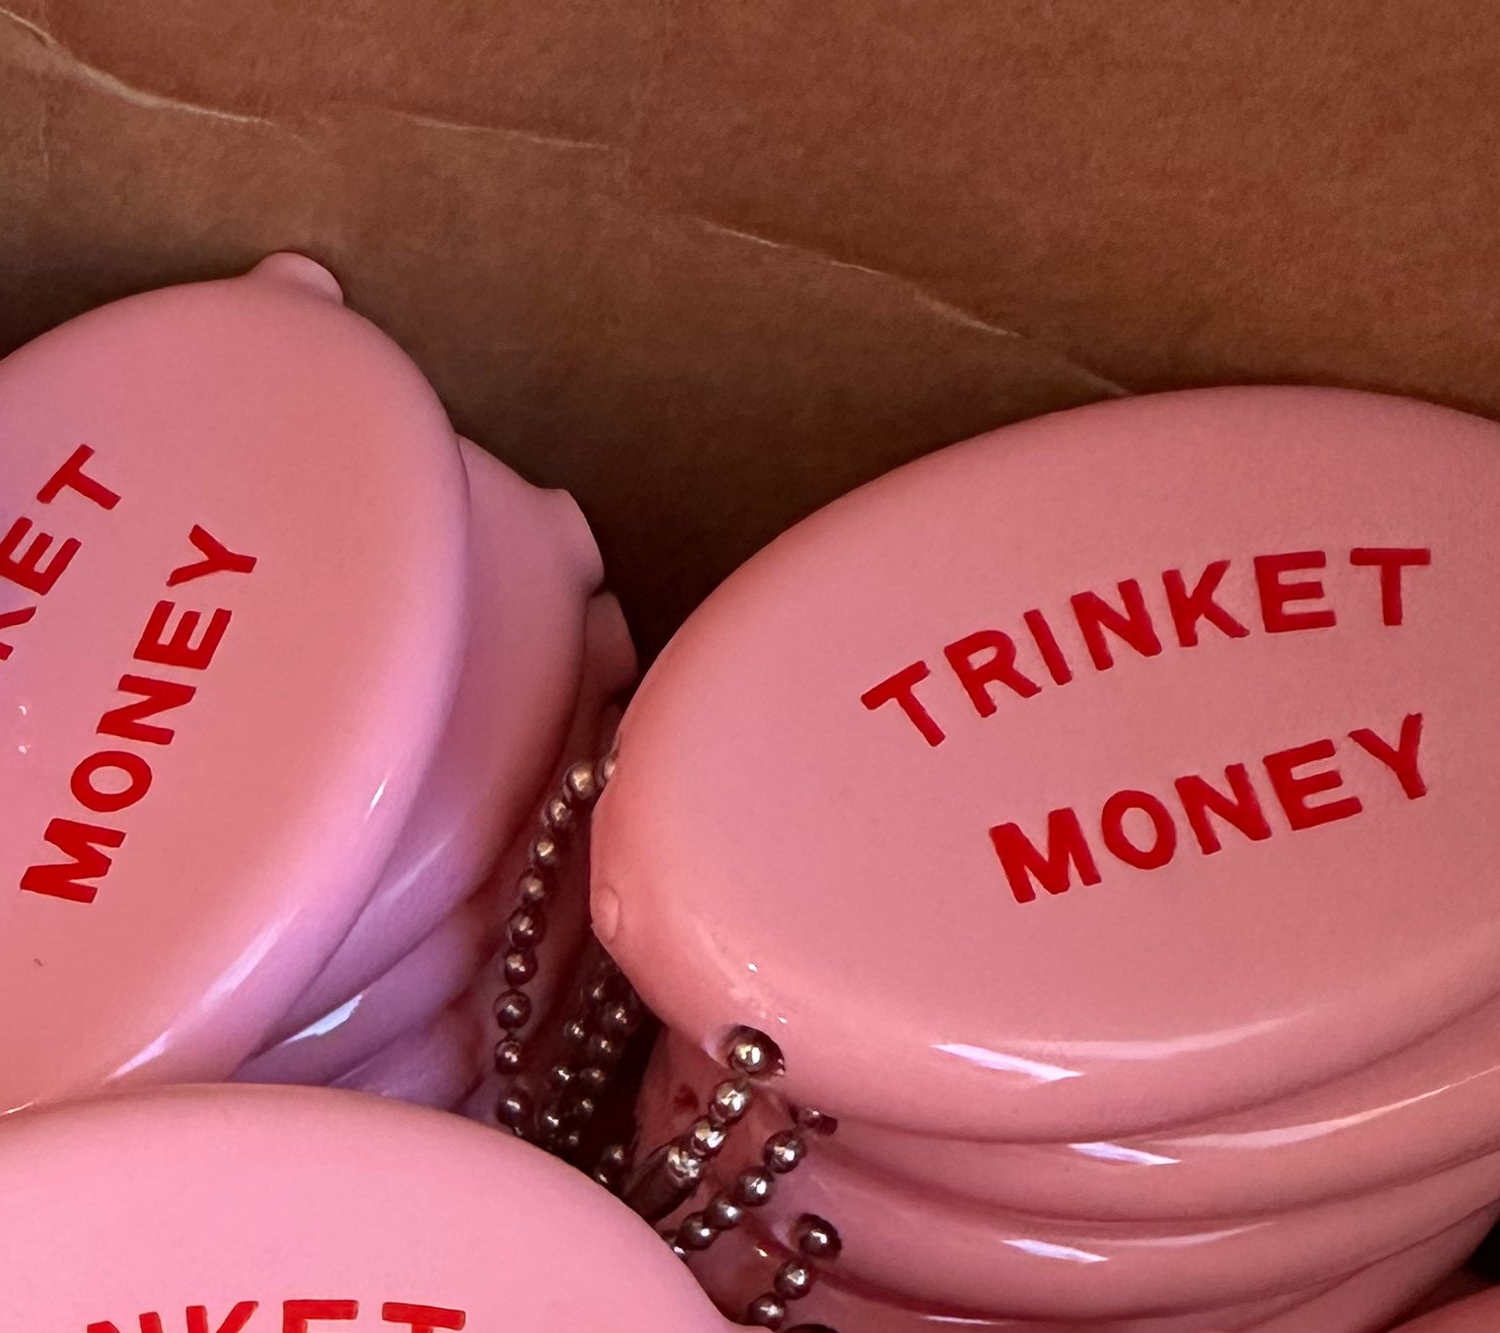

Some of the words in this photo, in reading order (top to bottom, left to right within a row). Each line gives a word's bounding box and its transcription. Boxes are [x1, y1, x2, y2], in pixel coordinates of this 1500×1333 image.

[20, 524, 257, 903] MONEY
[861, 547, 1431, 747] TRINKET
[989, 712, 1428, 903] MONEY
